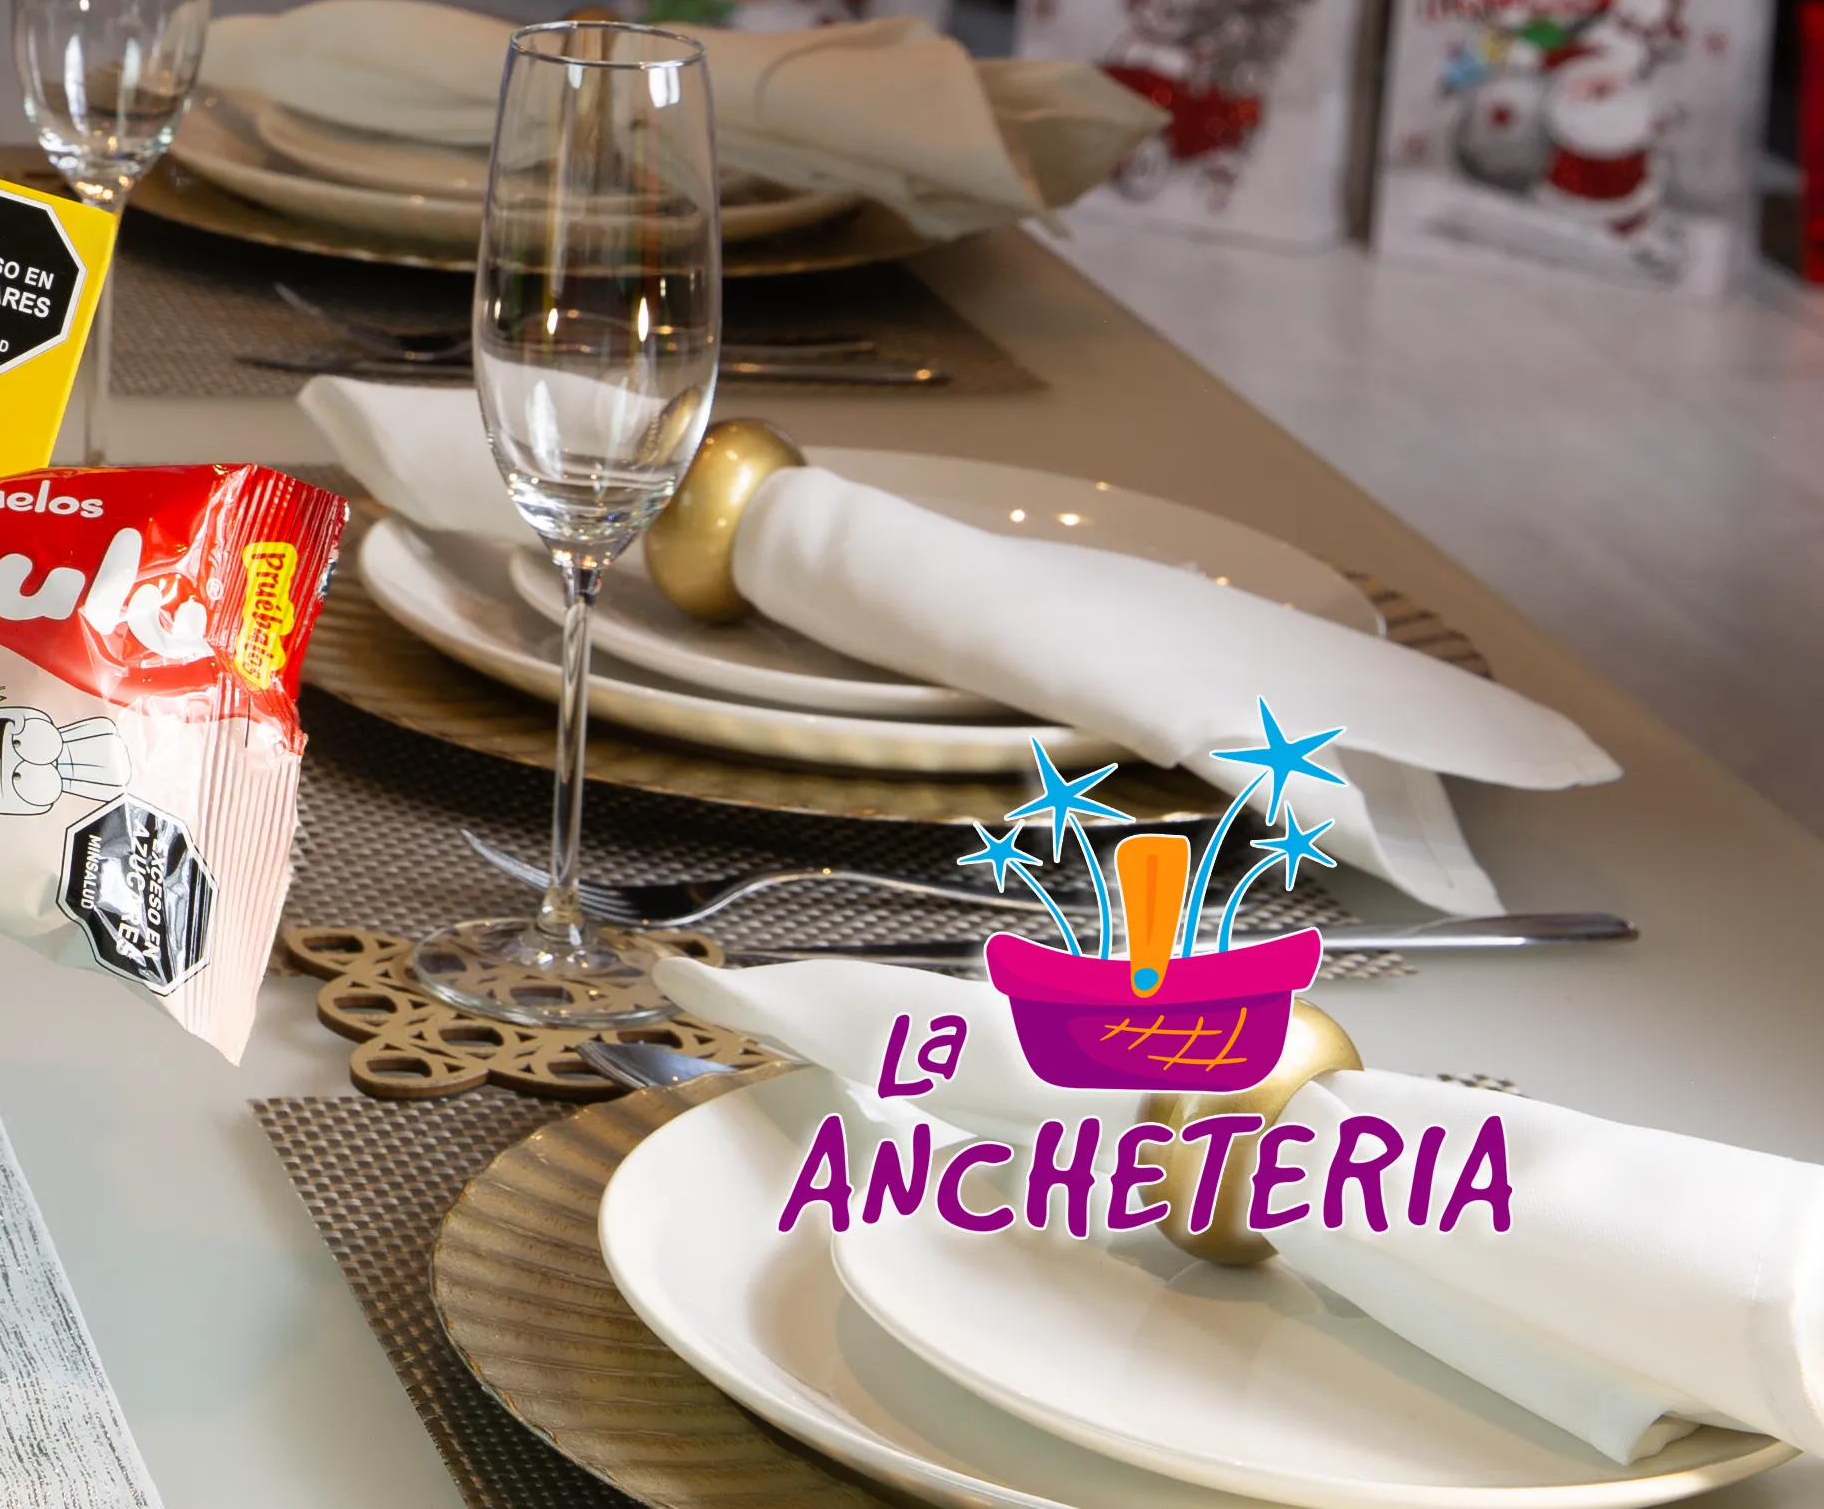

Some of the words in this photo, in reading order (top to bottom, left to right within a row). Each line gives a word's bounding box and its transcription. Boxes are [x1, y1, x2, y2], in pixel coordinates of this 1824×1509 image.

[24, 266, 55, 290] EN
[80, 835, 102, 909] MINSALUD
[147, 839, 166, 926] EXCESO
[142, 928, 162, 961] EN
